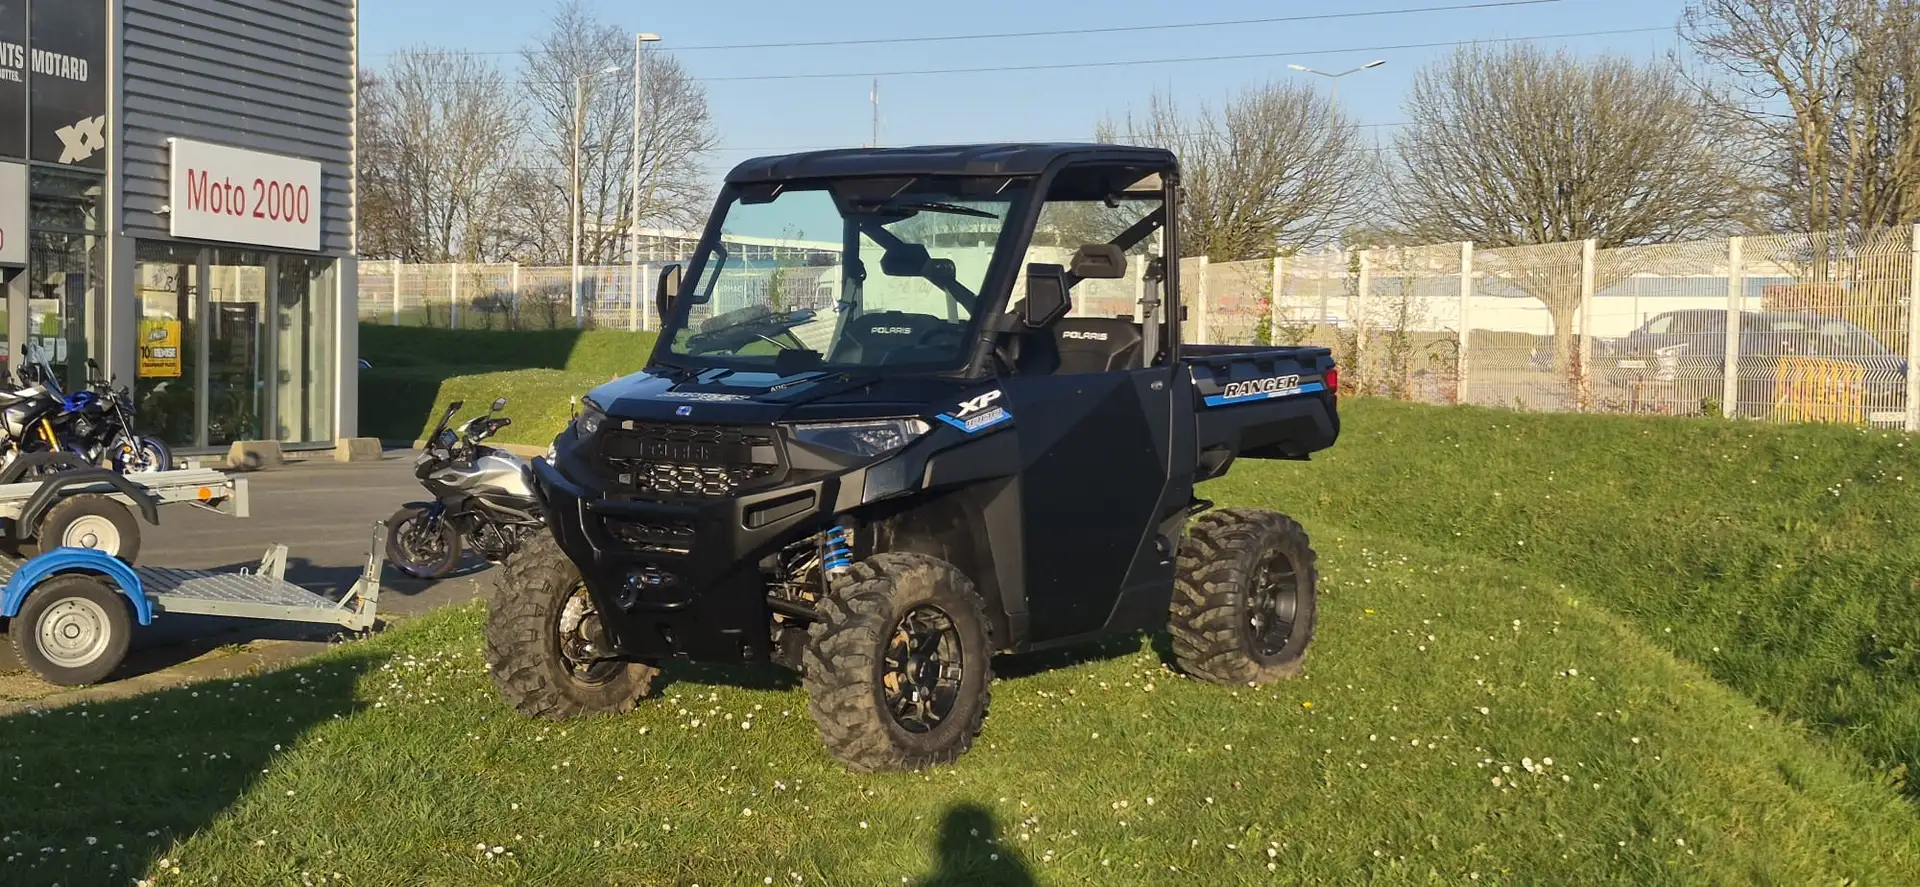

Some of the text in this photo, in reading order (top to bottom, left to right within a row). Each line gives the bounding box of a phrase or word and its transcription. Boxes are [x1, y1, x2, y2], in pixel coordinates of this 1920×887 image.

[31, 48, 88, 82] MOTARD
[187, 168, 309, 224] Moto 2000
[871, 326, 912, 335] POLARIS
[1062, 330, 1108, 341] POLARIS
[1224, 374, 1300, 399] RANGER
[955, 389, 1002, 418] XP
